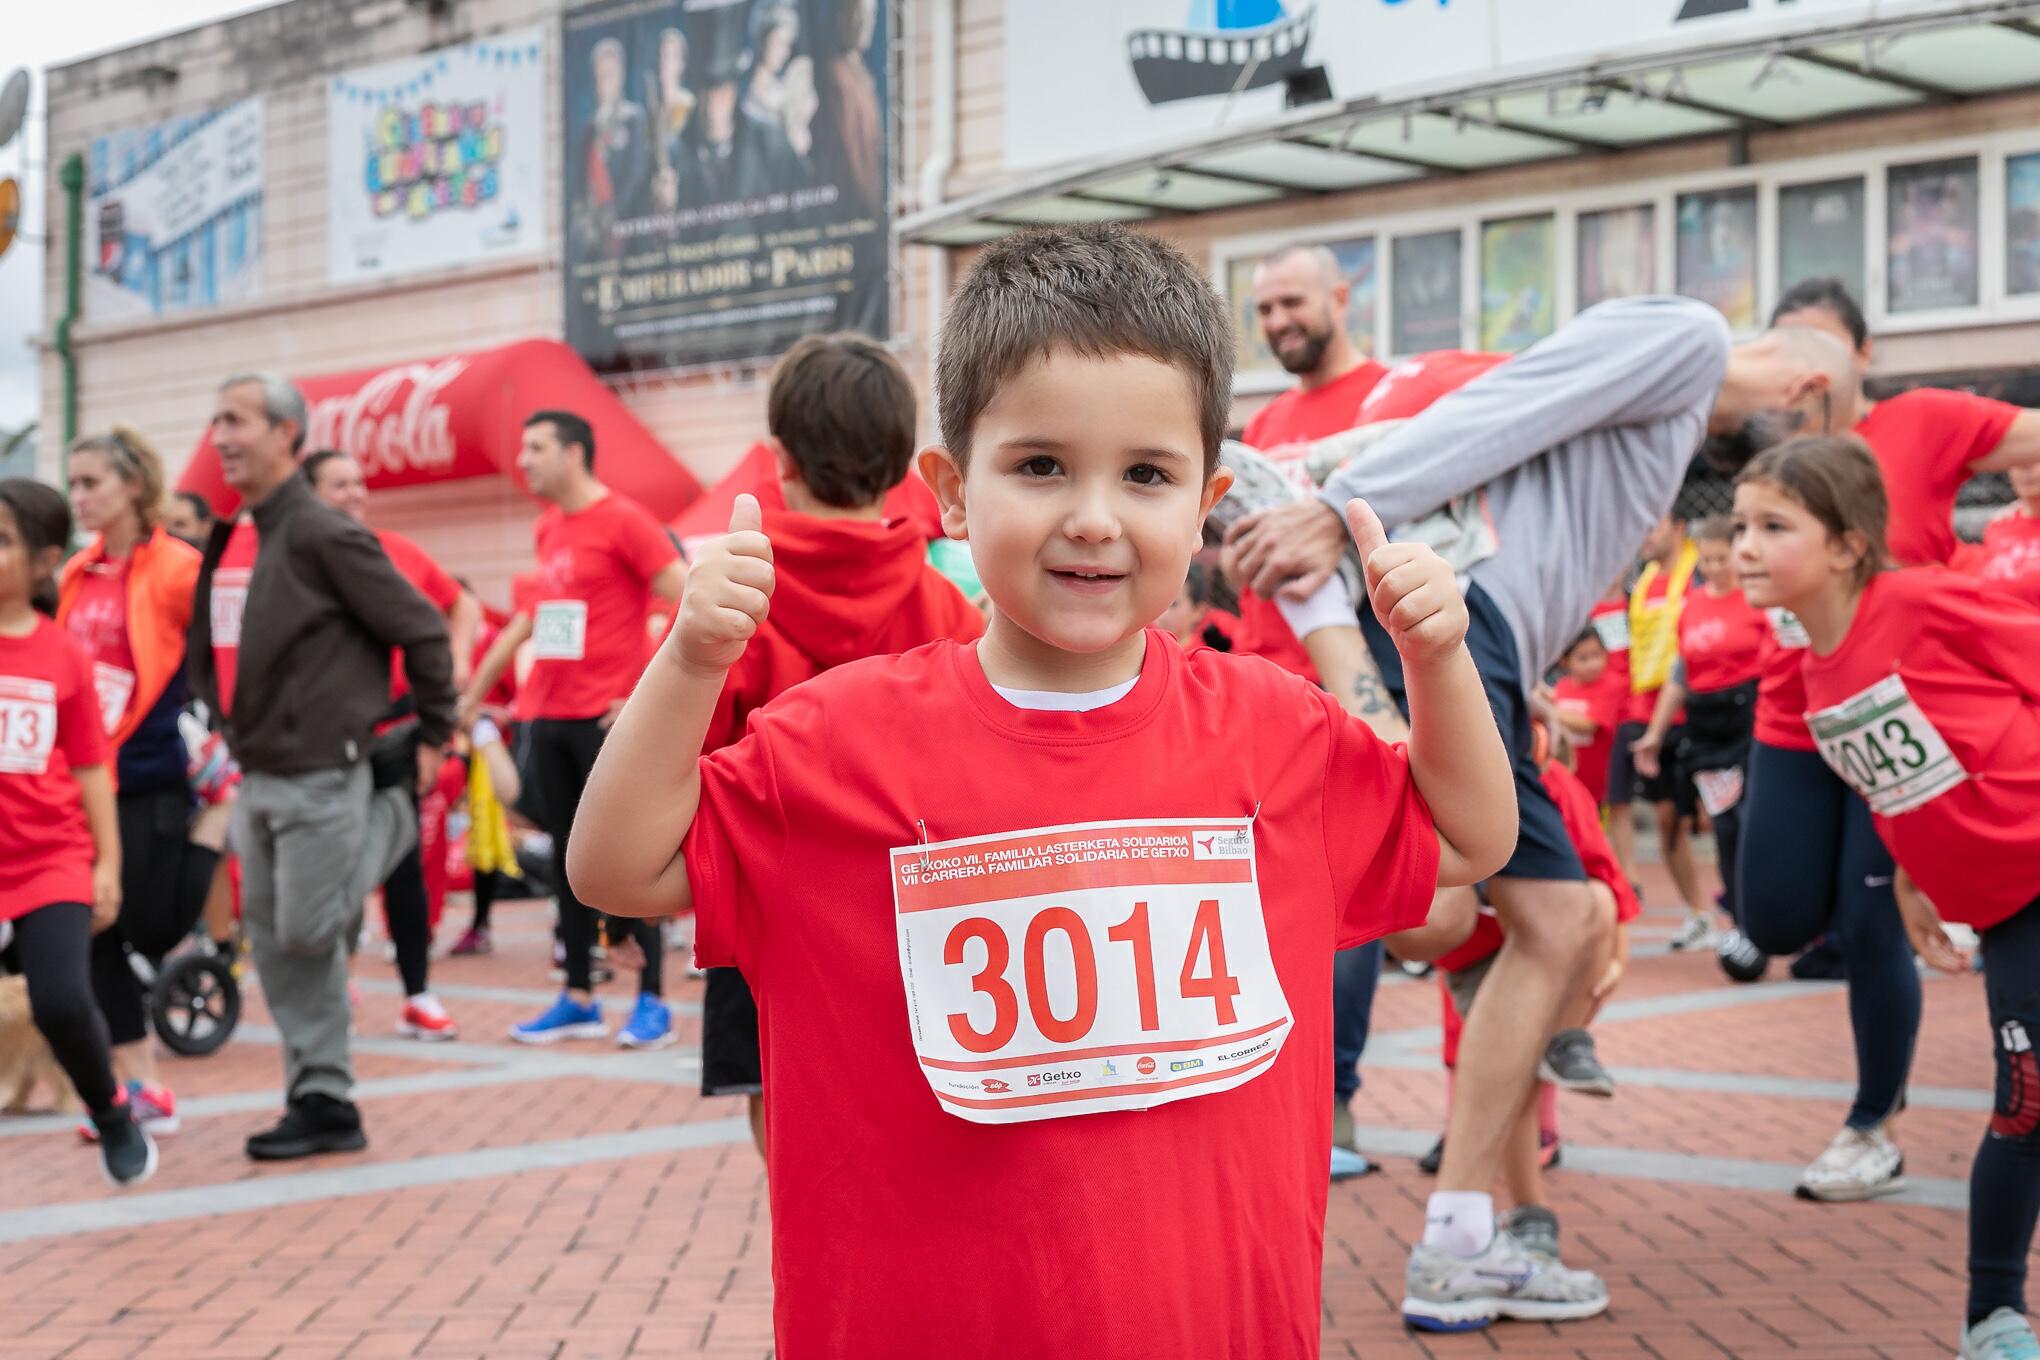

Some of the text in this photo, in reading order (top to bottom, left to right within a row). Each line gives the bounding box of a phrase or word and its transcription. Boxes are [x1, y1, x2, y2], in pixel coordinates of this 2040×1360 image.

[963, 854, 982, 866] VII.
[984, 847, 1035, 862] FAMILIA
[1038, 838, 1119, 856] LASTERKETA
[1122, 836, 1189, 847] SOLIDARIOA
[1218, 846, 1249, 856] Bilbao
[902, 847, 1190, 886] VII CARRERA FAMILIAR SOLIDARIA DE GETXO
[944, 900, 1240, 1053] 3014
[1042, 1071, 1082, 1082] Getxo
